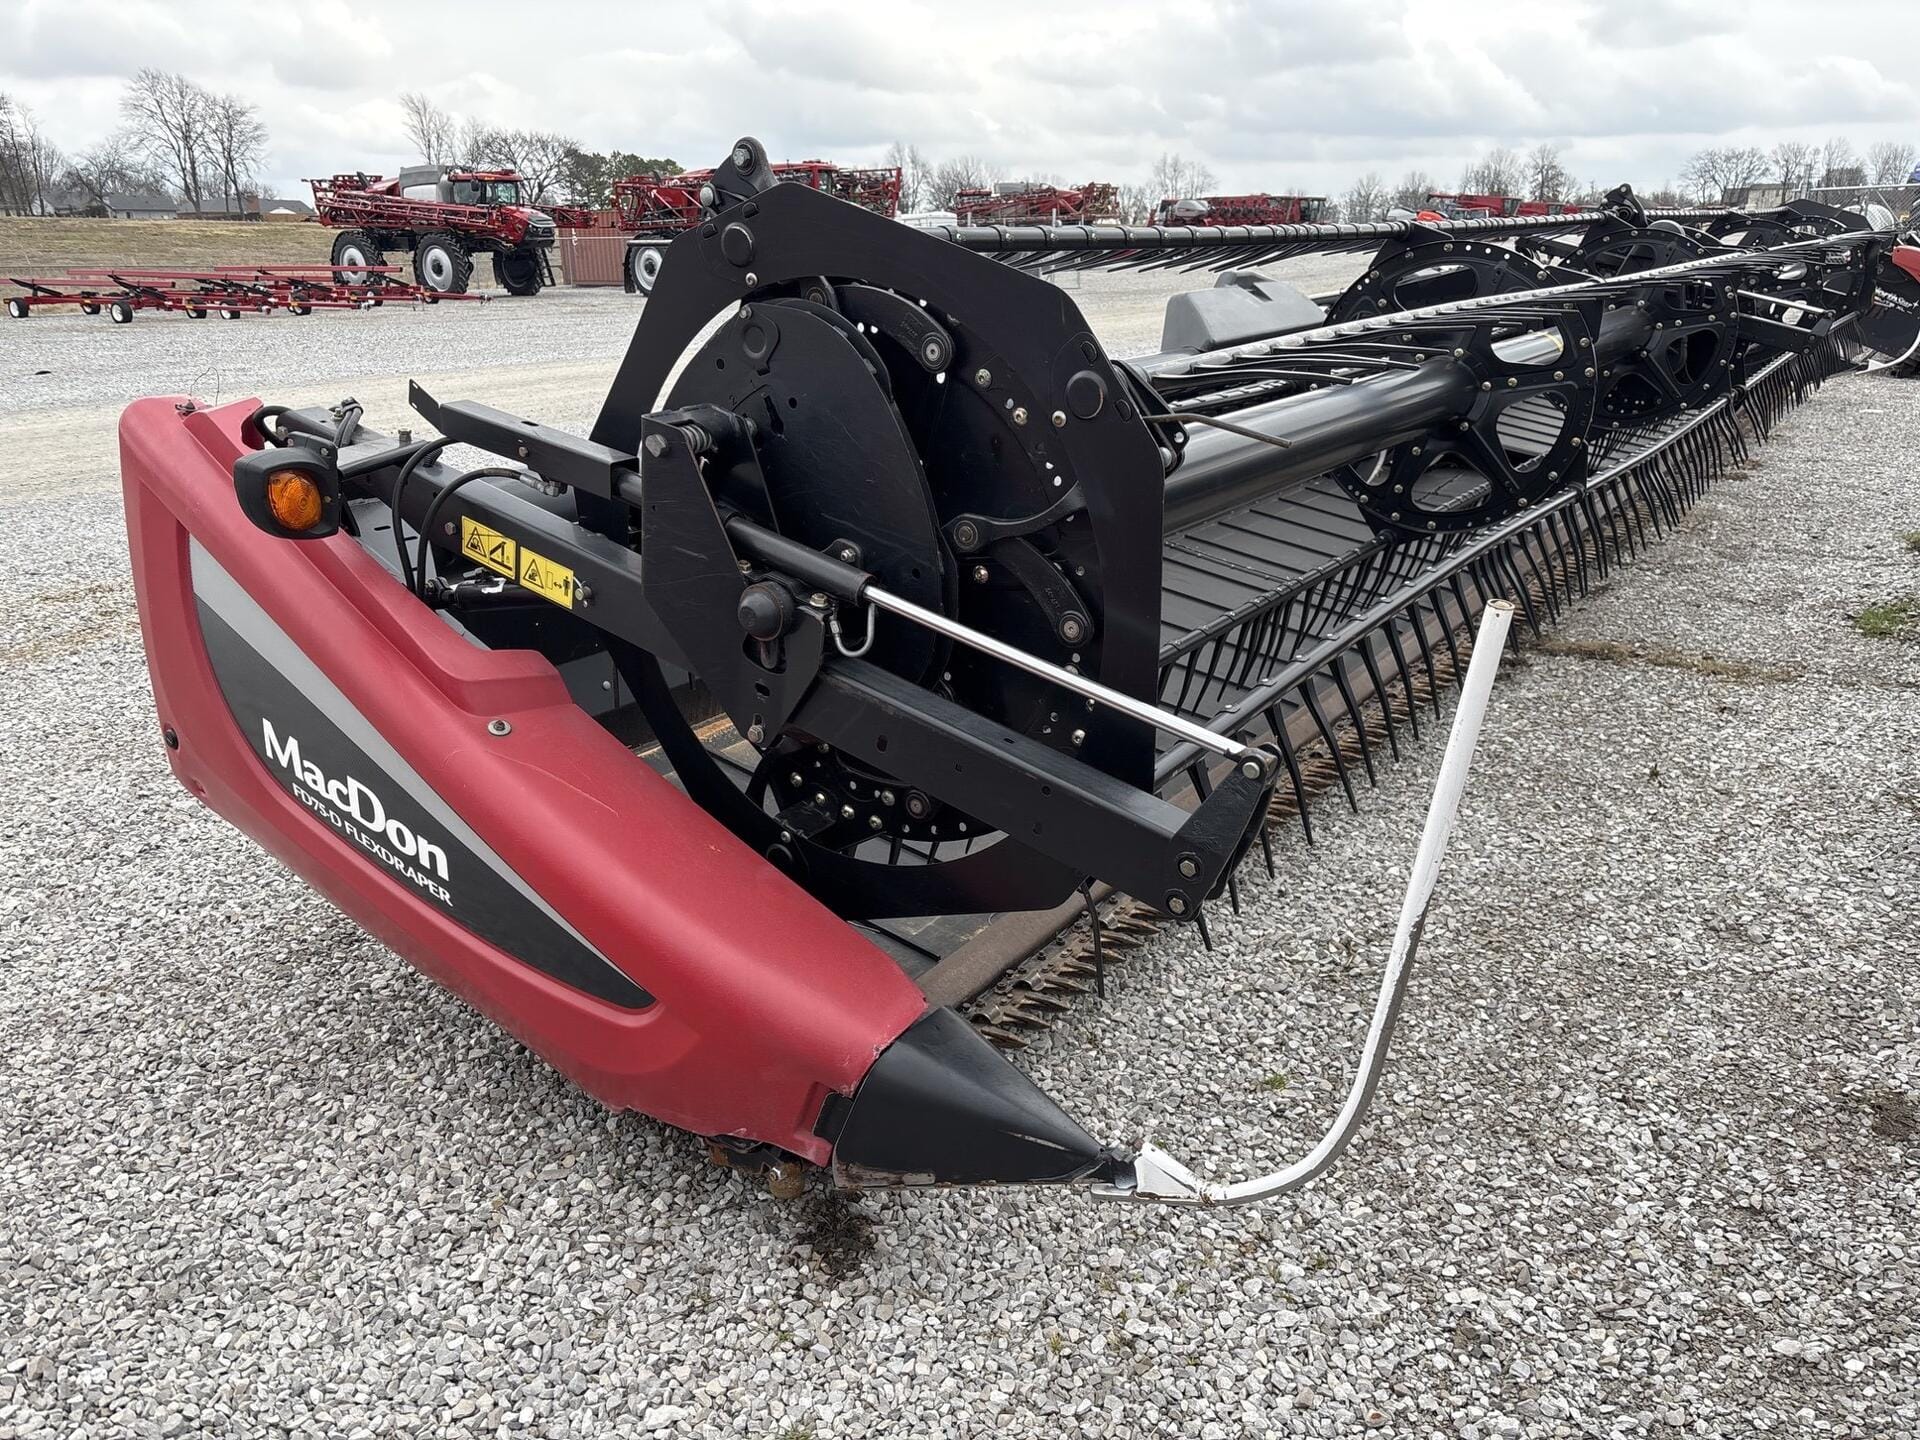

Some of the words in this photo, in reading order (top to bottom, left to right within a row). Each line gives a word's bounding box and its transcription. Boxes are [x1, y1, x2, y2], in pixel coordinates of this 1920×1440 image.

[262, 717, 449, 881] MacDon
[292, 782, 342, 828] FD75-D
[344, 821, 453, 907] FLEXDRAPER
